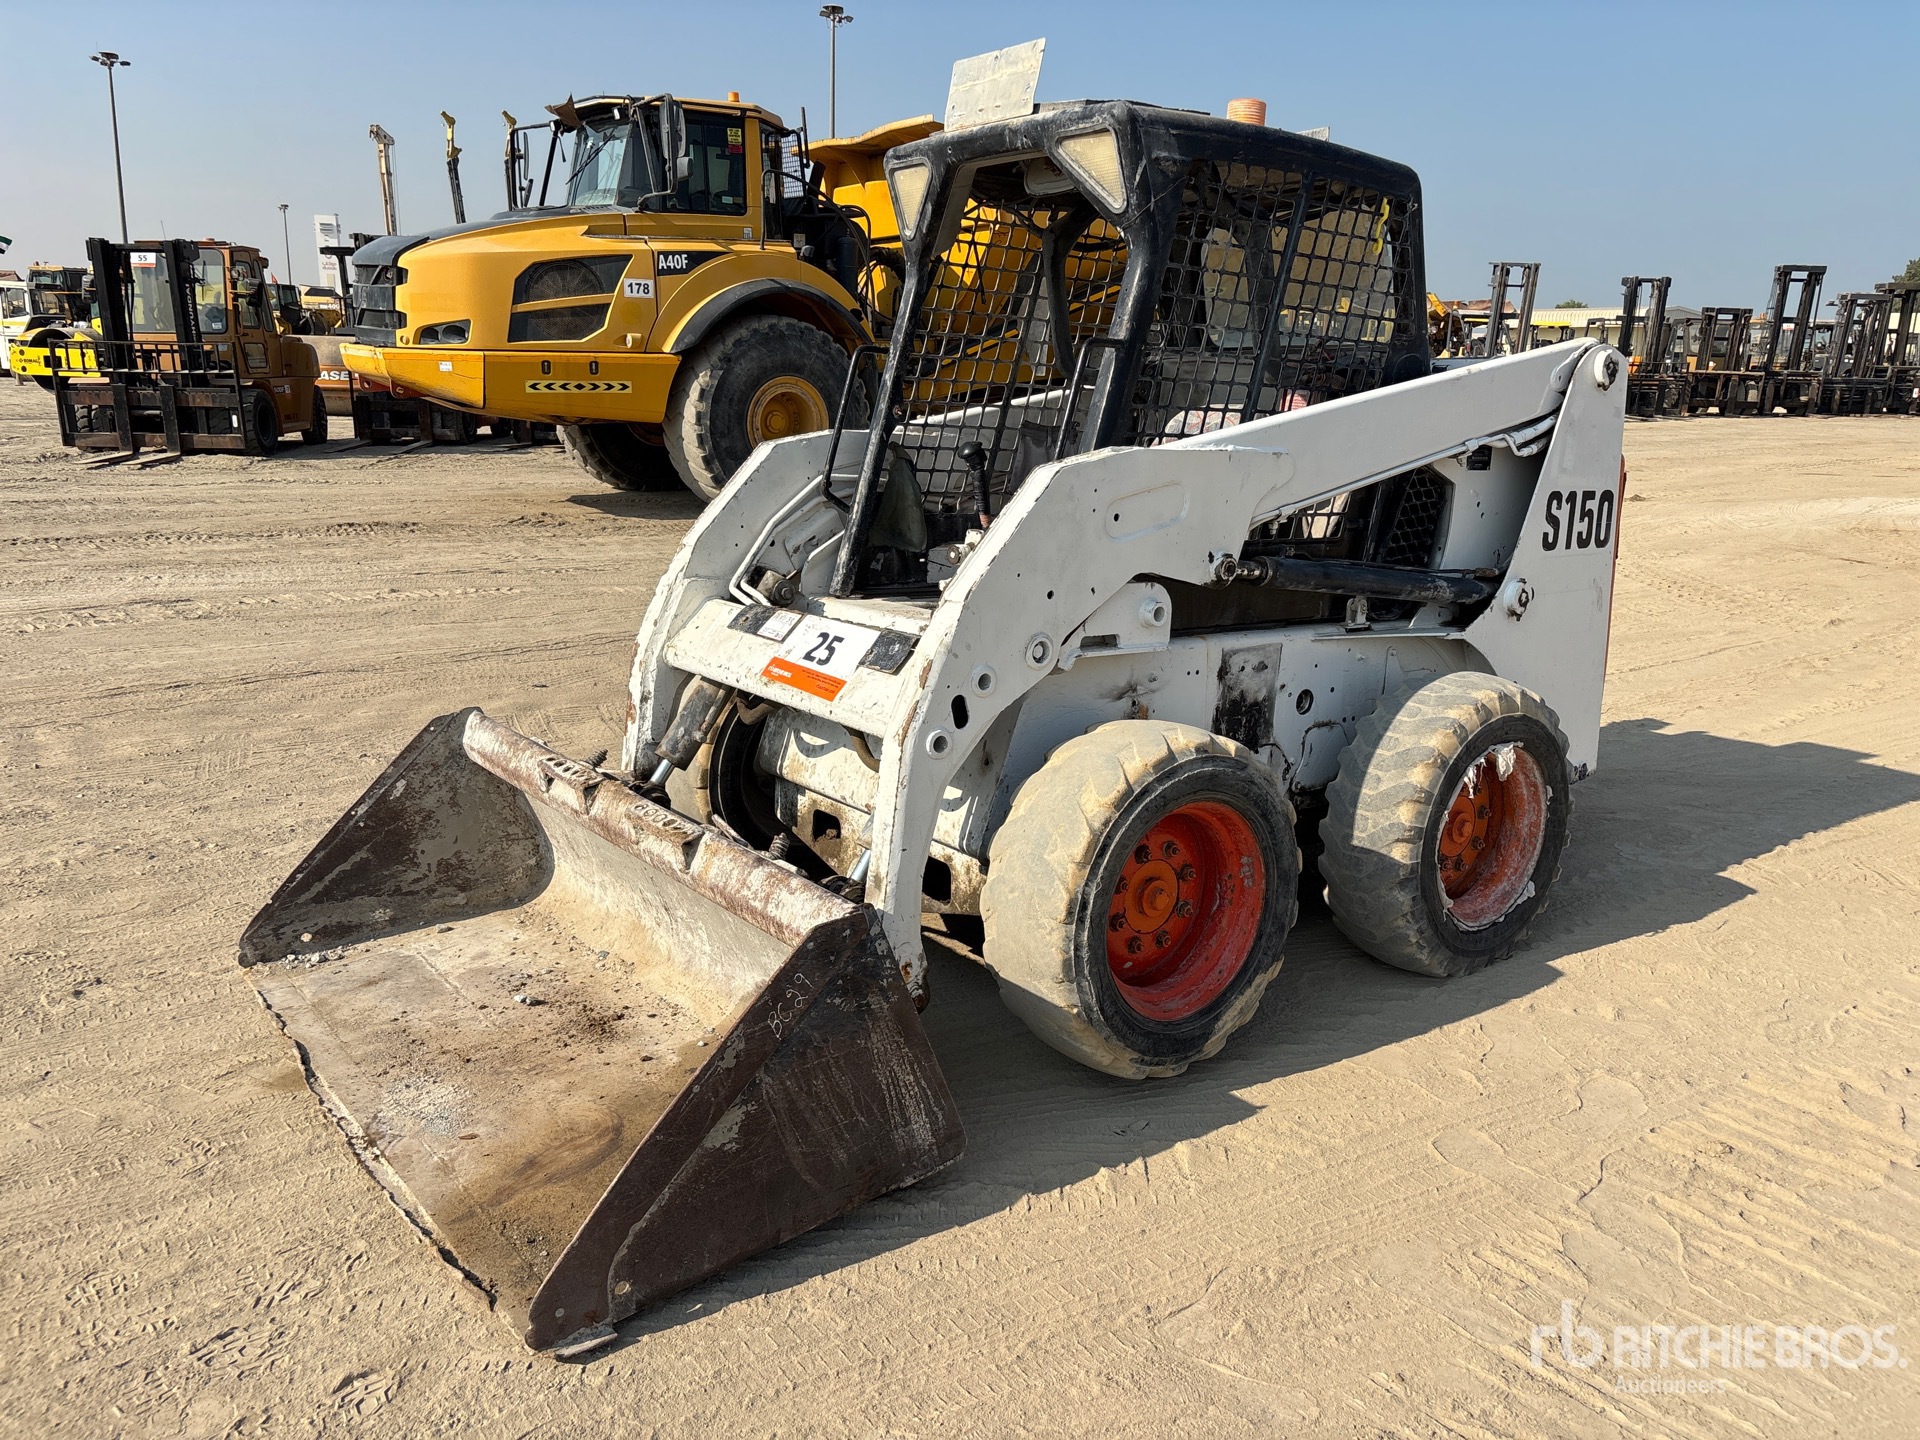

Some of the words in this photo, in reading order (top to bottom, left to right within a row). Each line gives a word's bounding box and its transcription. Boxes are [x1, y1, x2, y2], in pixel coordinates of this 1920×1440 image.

[138, 254, 148, 262] 55
[658, 254, 688, 269] A40F
[627, 282, 650, 295] 178
[185, 283, 196, 334] HYUNDAI
[317, 370, 349, 380] ASE
[1542, 489, 1614, 551] S150
[802, 631, 845, 666] 25
